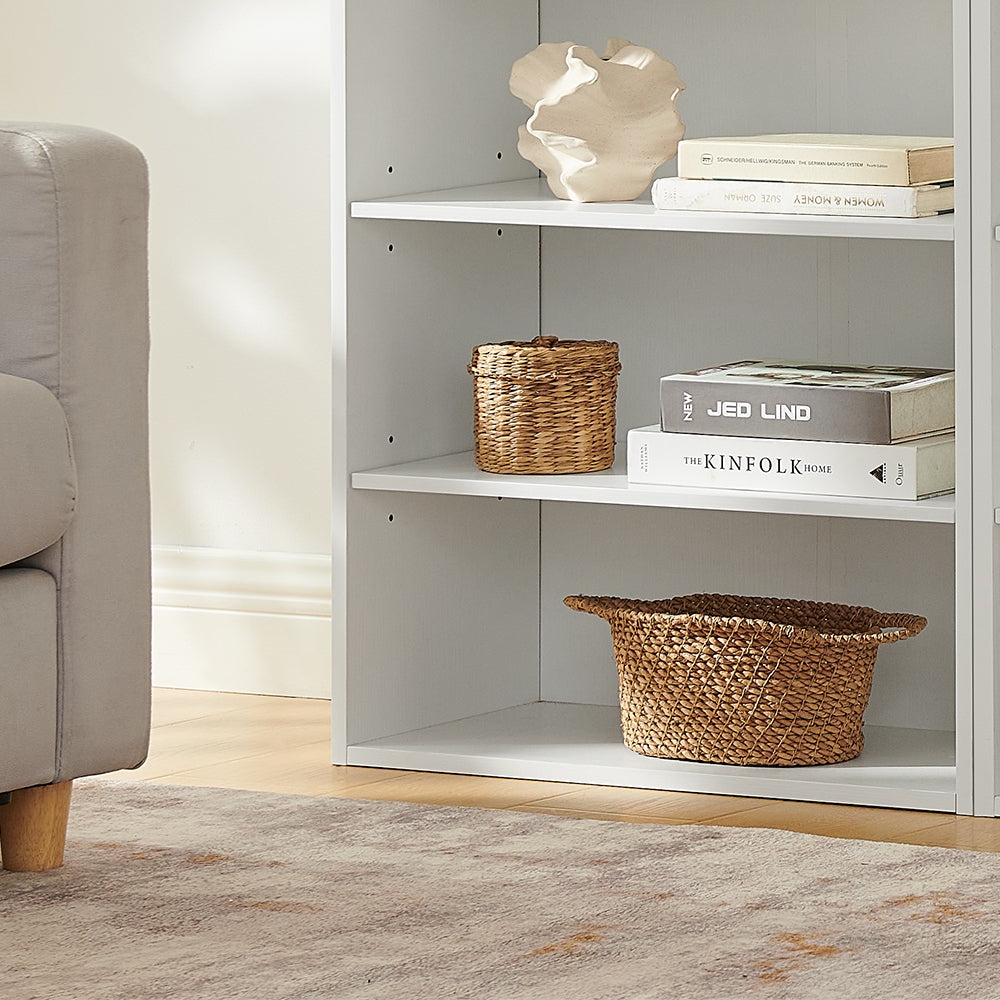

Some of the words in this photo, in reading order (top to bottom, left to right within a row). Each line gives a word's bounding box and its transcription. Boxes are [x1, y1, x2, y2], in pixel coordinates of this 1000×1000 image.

[724, 193, 757, 203] ORMAN
[760, 194, 781, 204] SUZE
[793, 194, 831, 206] MONEY
[834, 195, 841, 206] &
[844, 196, 886, 209] WOMEN
[683, 392, 693, 422] NEW
[707, 401, 752, 418] JED
[761, 403, 811, 421] LIND
[683, 456, 702, 466] THE
[704, 453, 803, 475] KINFOLK
[804, 463, 832, 474] HOME
